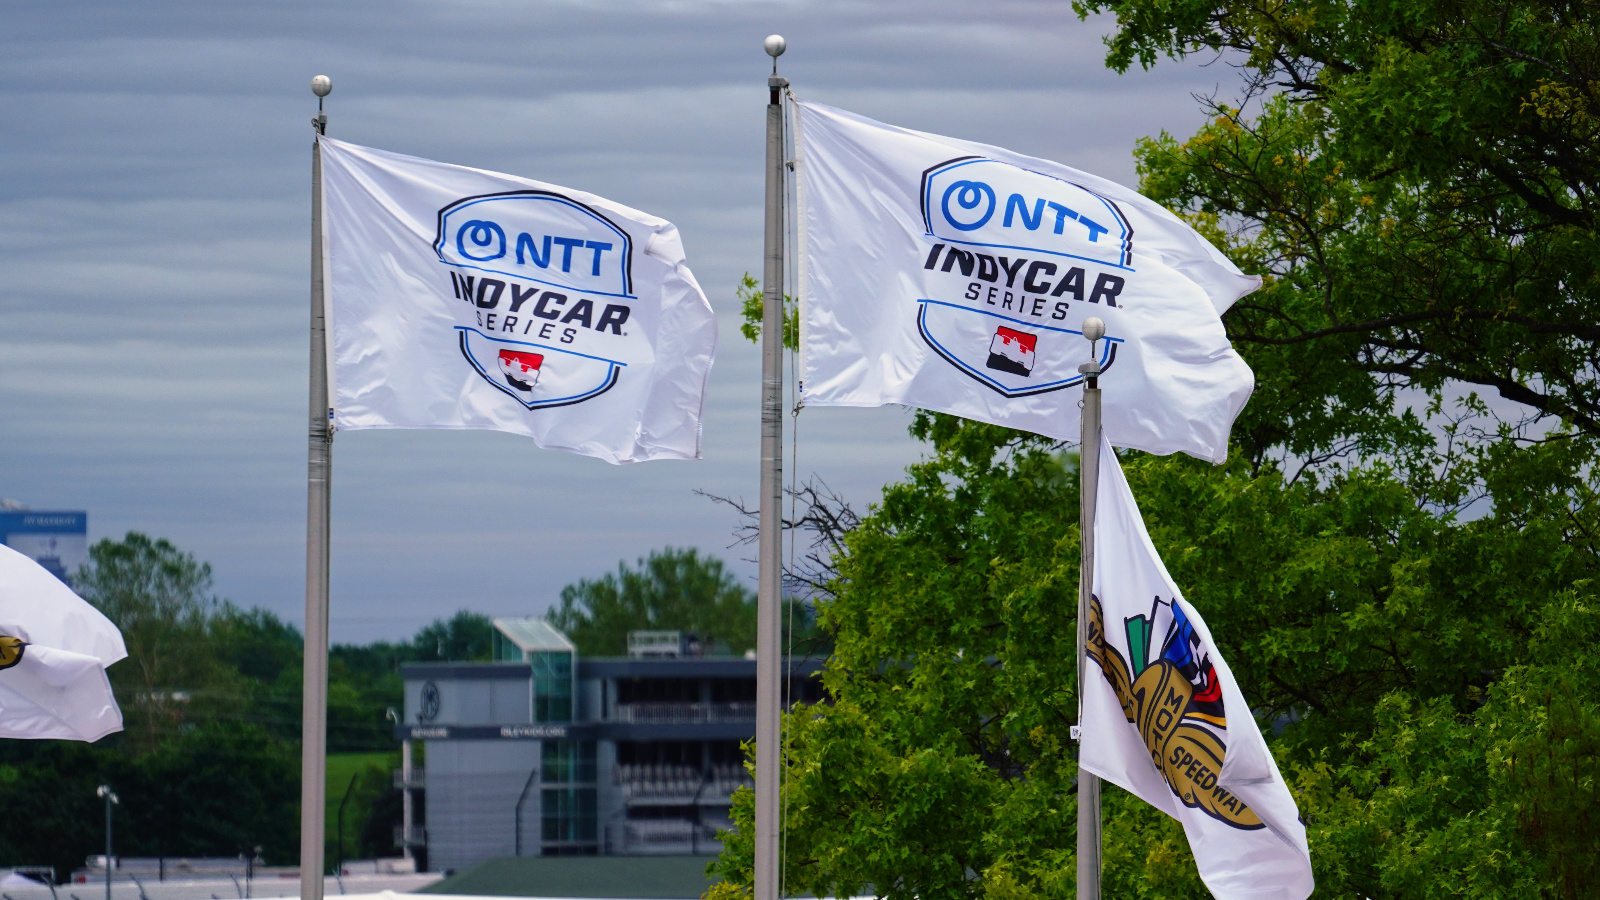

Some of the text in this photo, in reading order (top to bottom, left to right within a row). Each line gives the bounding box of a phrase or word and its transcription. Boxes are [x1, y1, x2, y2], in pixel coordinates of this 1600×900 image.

[1002, 193, 1109, 243] NTT
[515, 232, 613, 276] NTT
[923, 243, 1126, 308] INDYCAR
[449, 270, 631, 337] INDYCAR
[476, 310, 577, 344] SERIES
[964, 282, 1070, 321] SERIES
[1152, 686, 1184, 771] MOTO
[1169, 746, 1248, 816] SPEEDWAY
